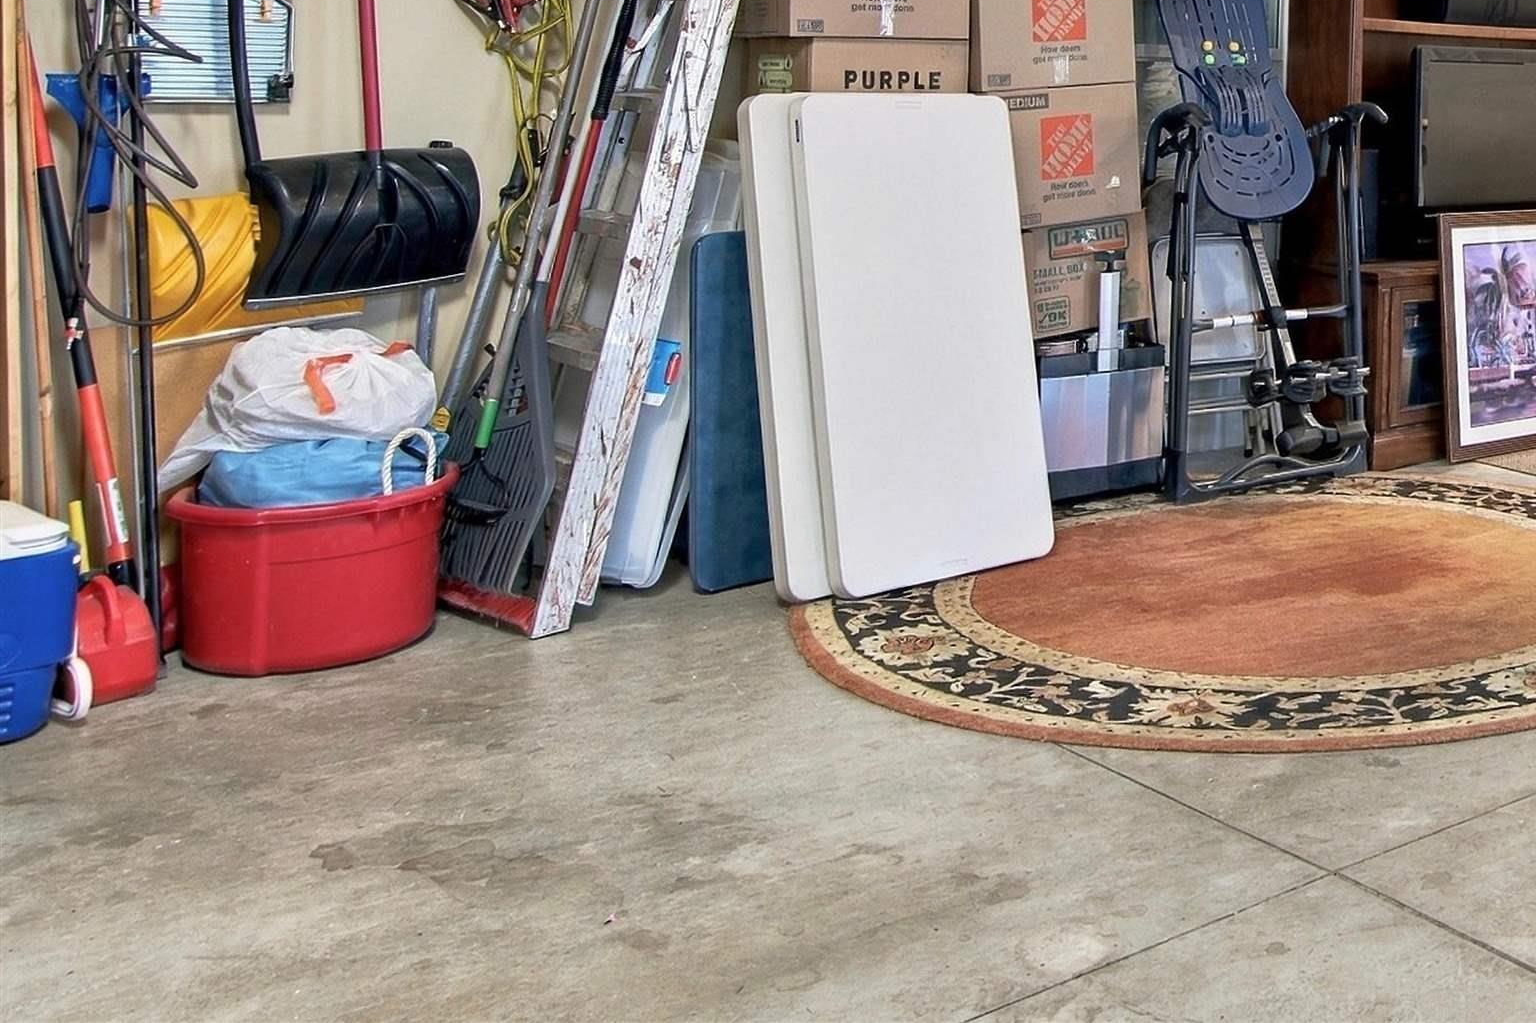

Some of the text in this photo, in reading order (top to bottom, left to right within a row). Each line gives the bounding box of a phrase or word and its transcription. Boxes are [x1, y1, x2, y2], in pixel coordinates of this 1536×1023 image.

[843, 70, 942, 91] PURPLE
[1006, 96, 1046, 109] EDIUM
[1042, 116, 1091, 177] HOME
